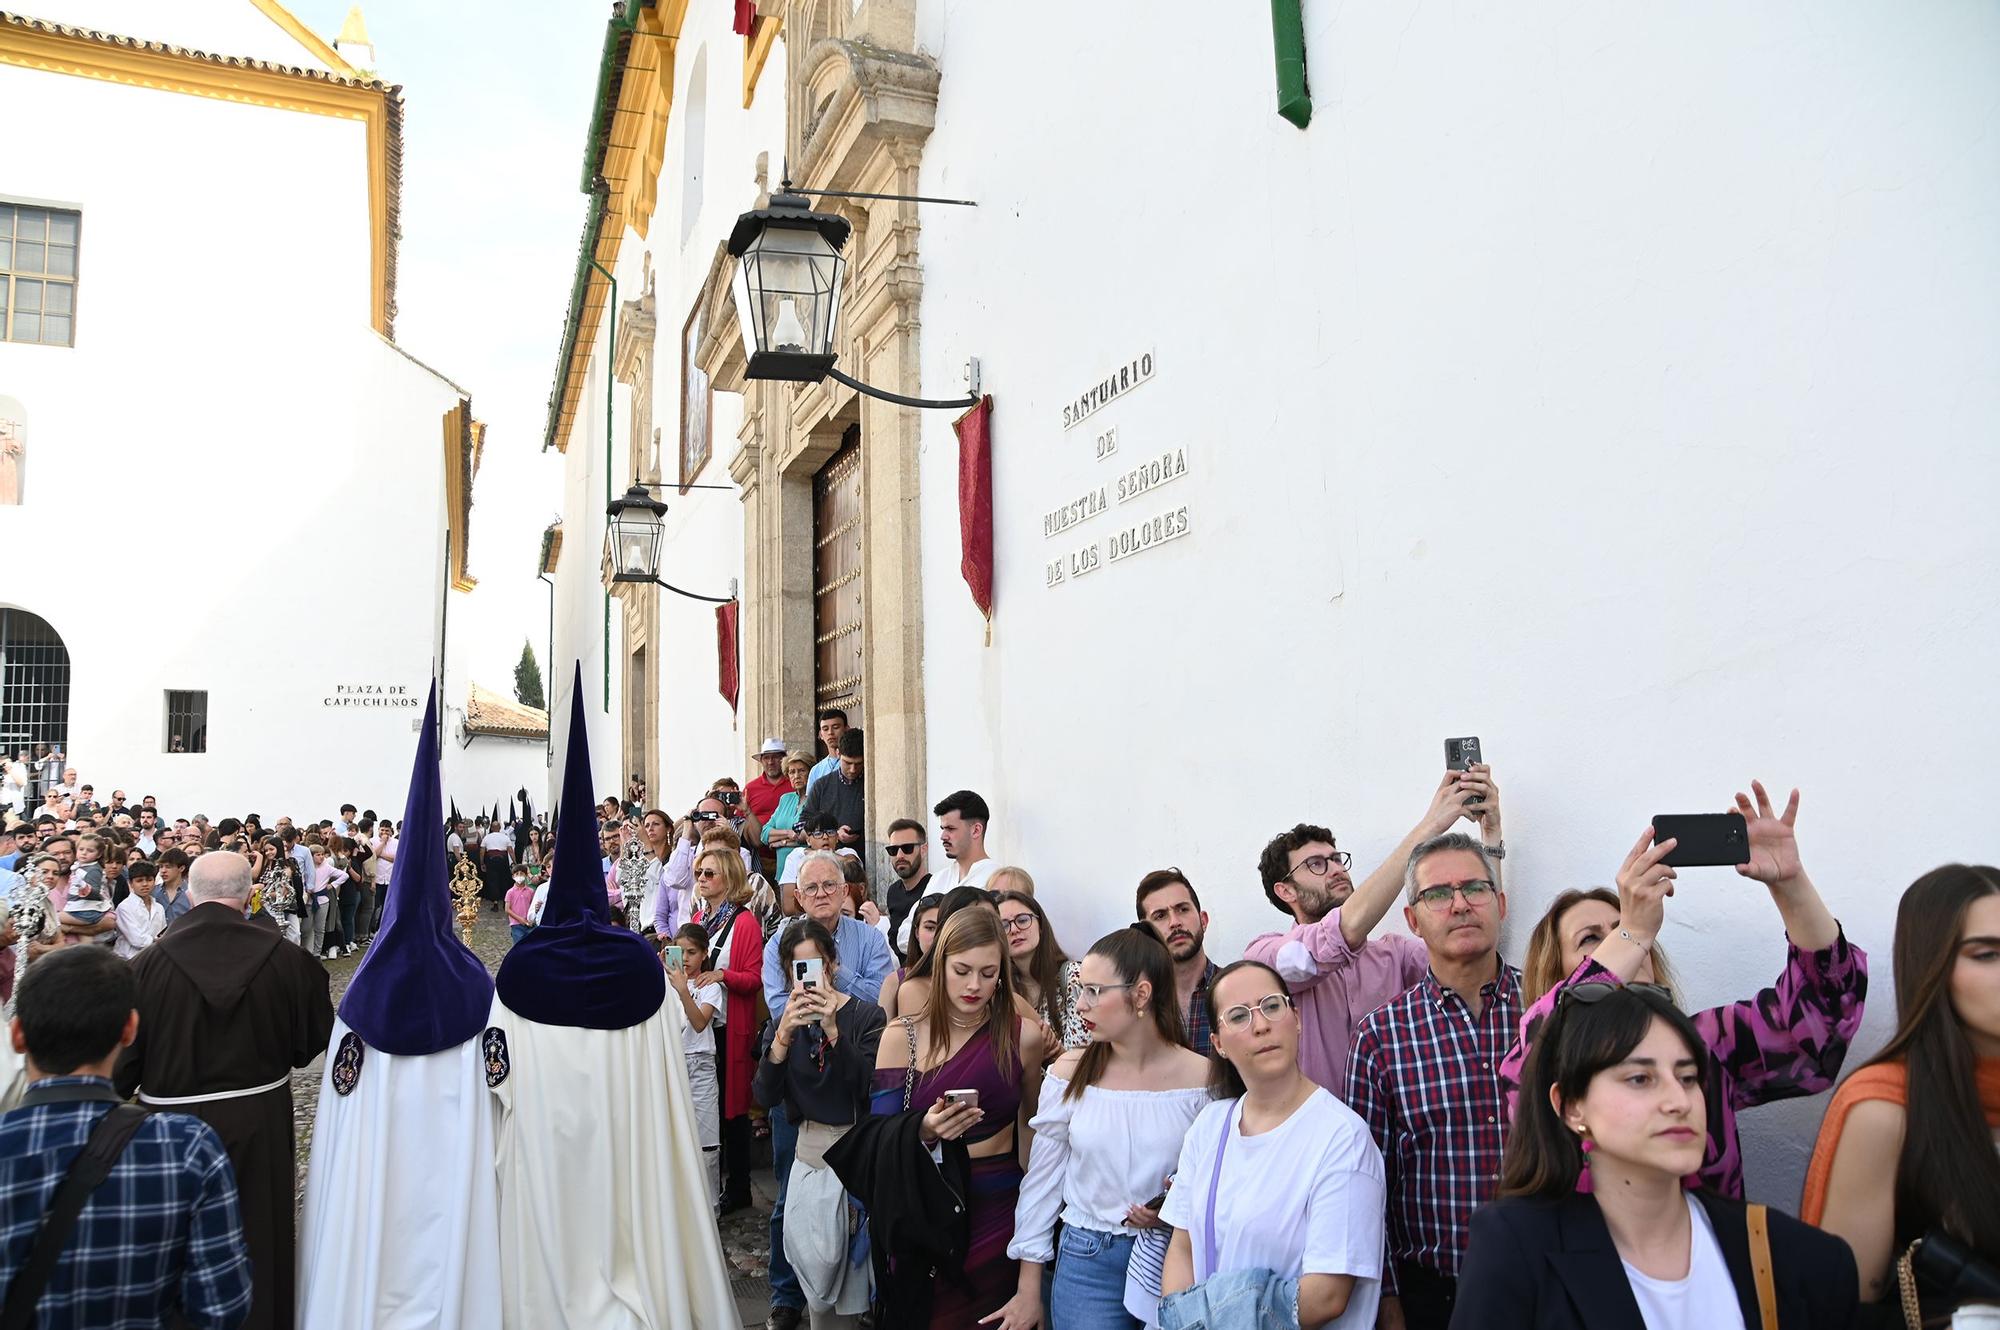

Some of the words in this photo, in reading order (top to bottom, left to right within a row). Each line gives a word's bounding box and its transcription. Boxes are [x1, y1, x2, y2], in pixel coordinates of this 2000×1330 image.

[1063, 353, 1152, 428] SANTUARIO
[1096, 428, 1116, 459] DE
[1044, 487, 1107, 537] NUESTRA
[1118, 448, 1186, 501] SEÑORA
[1046, 558, 1063, 585] DE
[1071, 543, 1098, 575] LOS
[1109, 506, 1188, 560] DOLORES
[324, 697, 418, 707] CAPUCHINOS
[337, 685, 382, 694] PLAZA
[389, 686, 406, 694] DE
